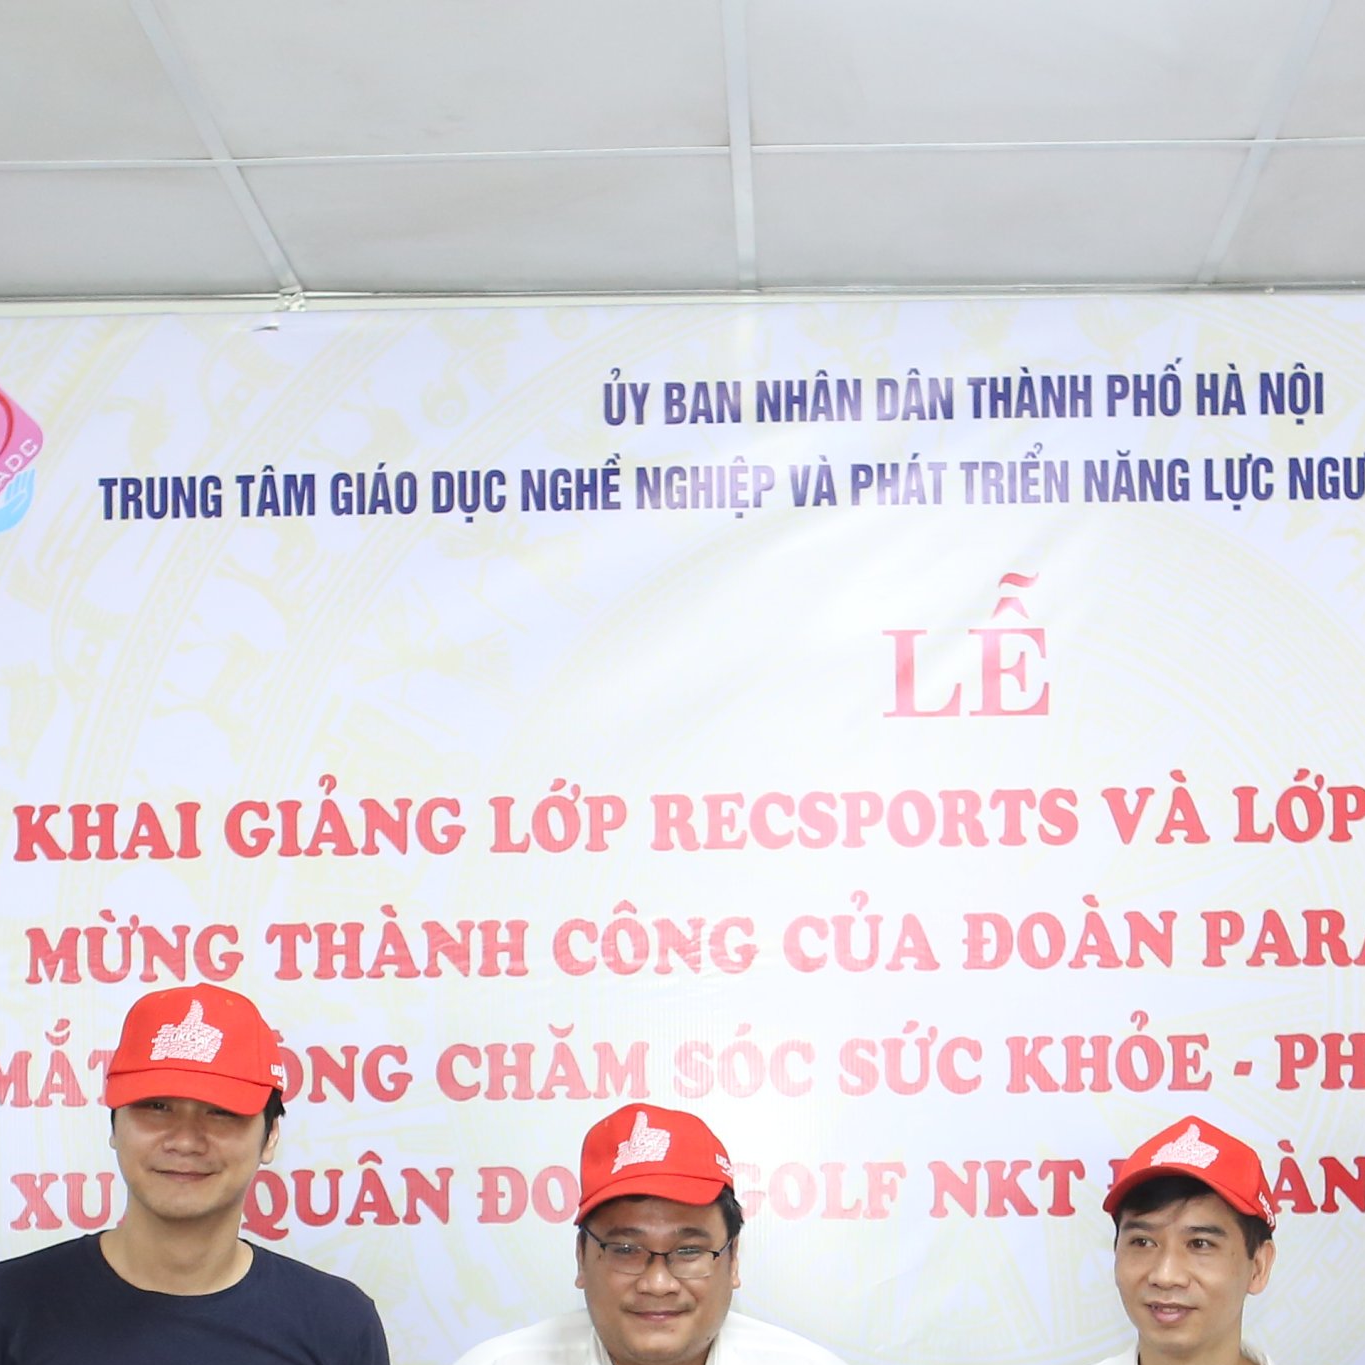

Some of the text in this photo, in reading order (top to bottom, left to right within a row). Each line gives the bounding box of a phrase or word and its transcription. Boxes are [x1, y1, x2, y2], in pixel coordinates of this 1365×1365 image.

[603, 356, 1323, 425] ỦY BAN NHÂN DÂN THÀNH PHỐ HÀ NỘI
[94, 474, 221, 520] TRUNG
[235, 464, 315, 518] TÂM
[325, 462, 416, 517] GIÁO
[431, 468, 506, 524] DỤC
[519, 454, 619, 512] NGHỀ
[635, 456, 774, 520] NGHIỆP
[790, 453, 837, 508] VÀ
[851, 451, 947, 506] PHÁT
[964, 442, 1069, 506] TRIỂN
[1083, 449, 1193, 503] NĂNG
[1203, 452, 1274, 512] LỰC
[882, 572, 1051, 718] LỄ
[12, 801, 203, 863] KHAI
[223, 773, 467, 859] GIẢNG
[488, 777, 628, 854] LỚP
[651, 788, 1079, 852] RECSPORTS
[1100, 768, 1211, 845] VÀ
[26, 908, 245, 986] MỪNG
[265, 903, 529, 981] THÀNH
[552, 900, 759, 975] CÔNG
[783, 890, 940, 973] CỦA
[962, 893, 1178, 970] ĐOÀN
[436, 1024, 651, 1102] CHĂM
[673, 1024, 815, 1098] SÓC
[839, 1020, 983, 1096] SỨC
[1005, 1009, 1213, 1094] KHỎE
[243, 1151, 454, 1240] QUÂN
[477, 1167, 579, 1226] ĐO
[928, 1158, 1086, 1219] NKT
